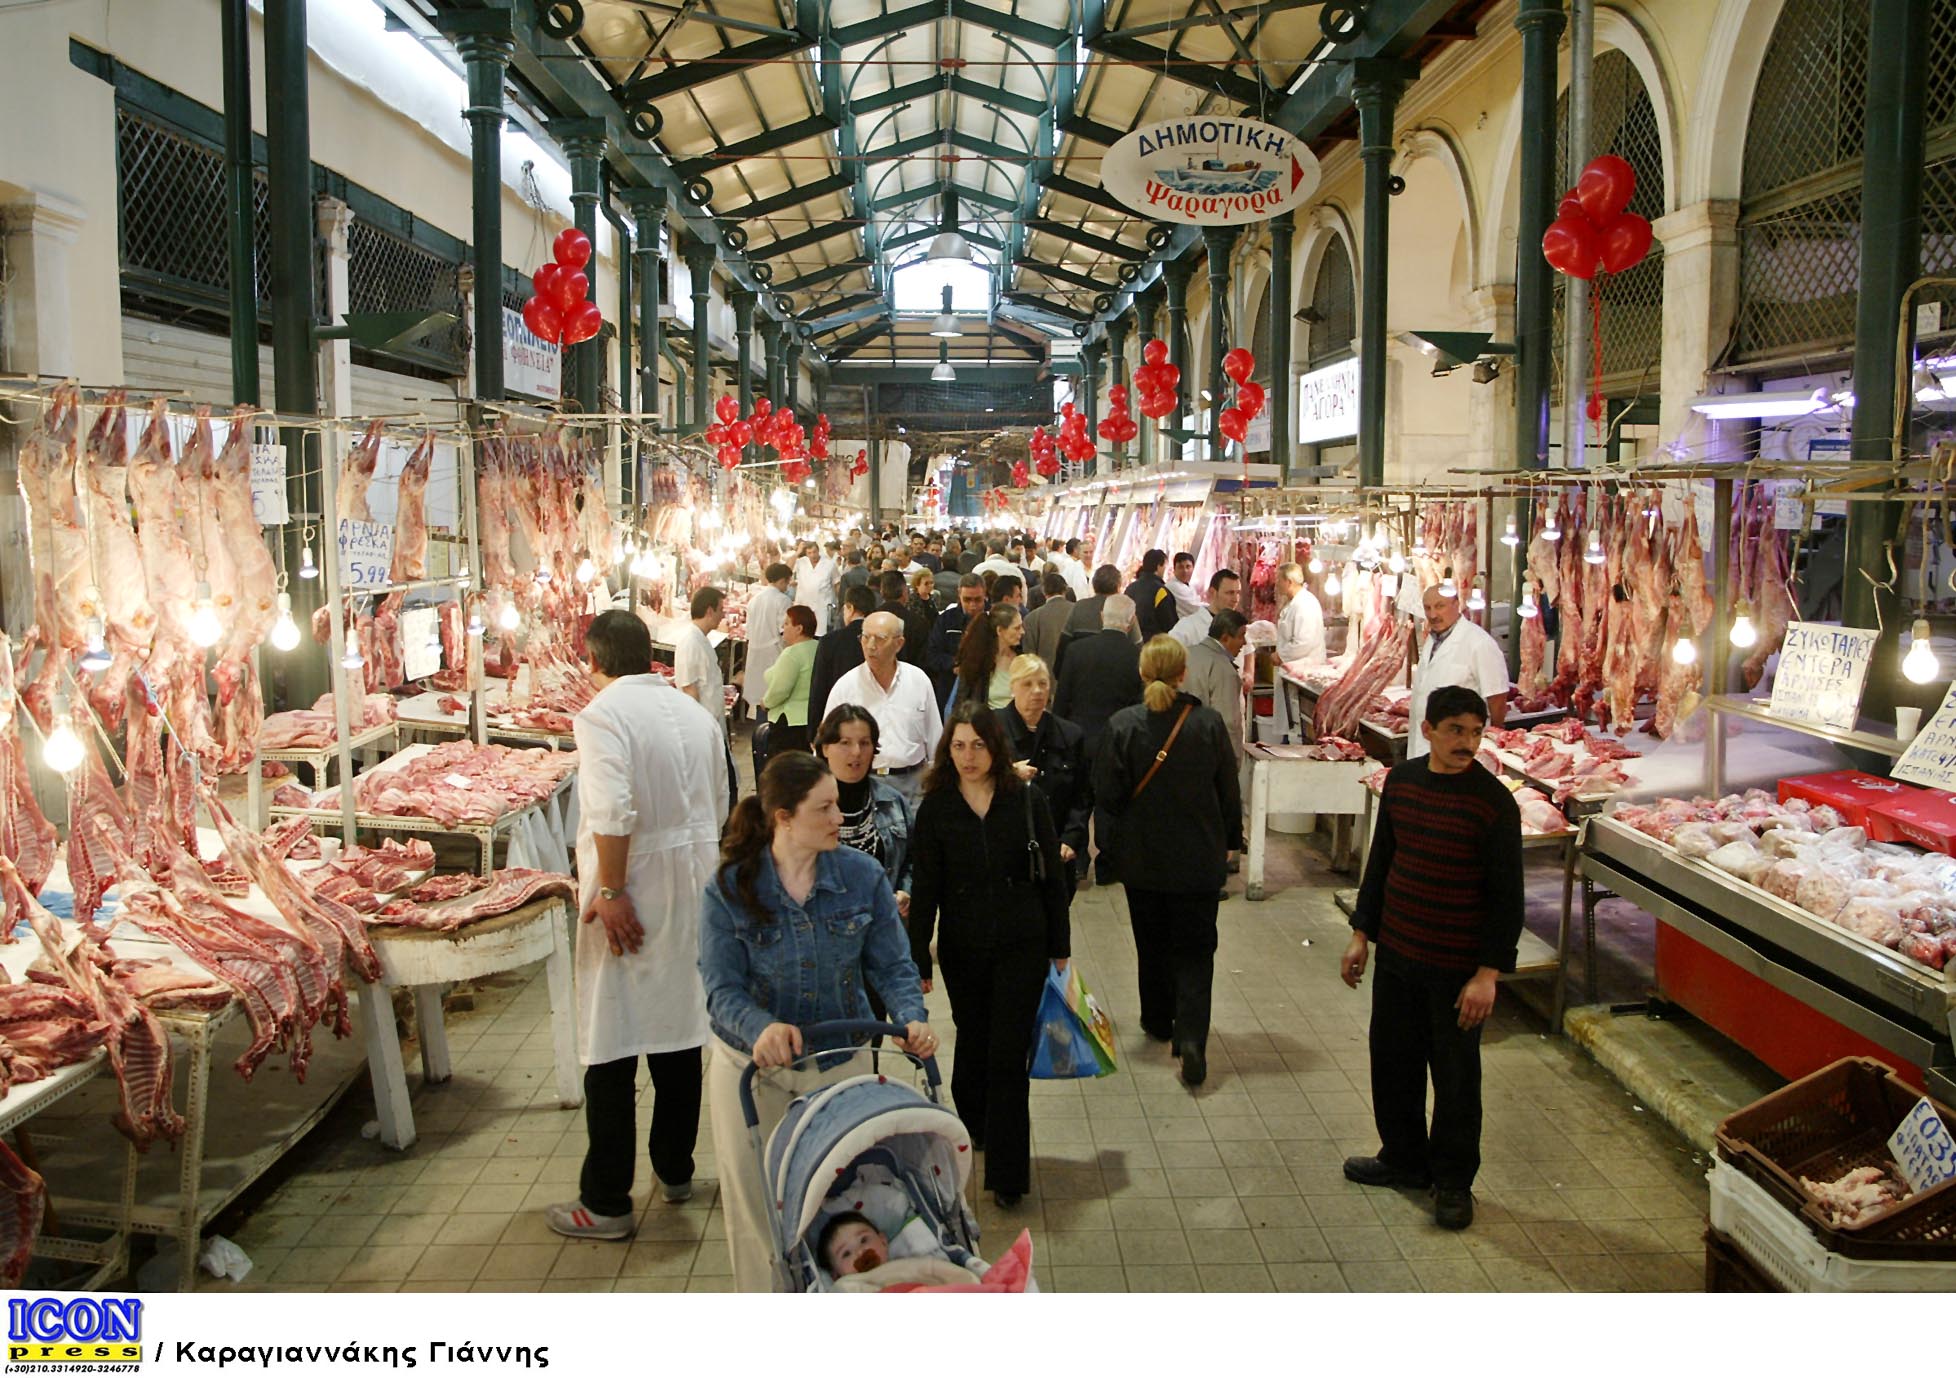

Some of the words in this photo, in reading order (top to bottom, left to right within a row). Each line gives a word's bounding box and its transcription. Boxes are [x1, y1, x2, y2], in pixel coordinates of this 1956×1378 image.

[1138, 121, 1285, 157] ΔΗΜΟΤΙΚΗ
[1145, 180, 1284, 220] Ψαραγορά
[350, 561, 386, 585] 5.99
[1781, 650, 1853, 679] ΕΝΤΕΡΑ
